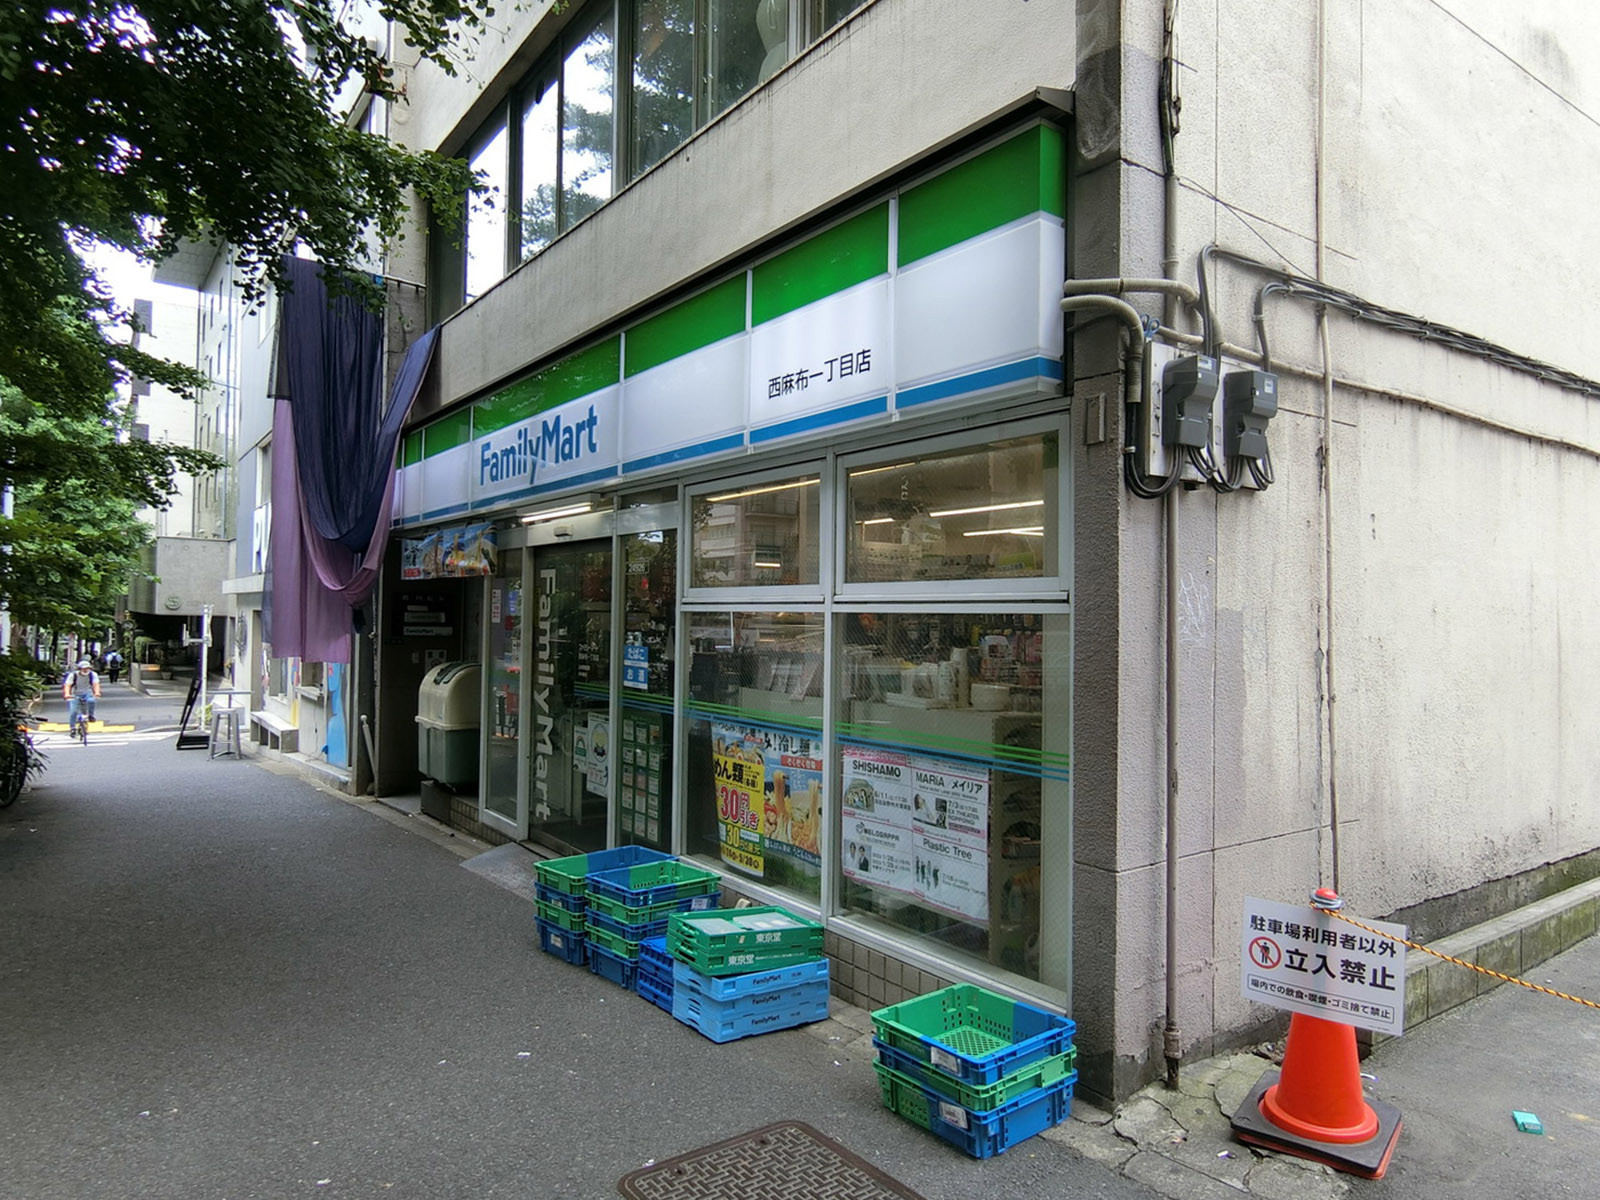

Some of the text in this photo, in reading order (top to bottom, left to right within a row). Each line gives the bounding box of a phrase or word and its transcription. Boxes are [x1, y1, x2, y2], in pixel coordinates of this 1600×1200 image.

[768, 349, 871, 399] 西麻布一丁目店
[480, 404, 599, 485] FamilyMart
[534, 568, 557, 821] FamilyMart
[852, 759, 902, 778] SHISHAMO
[915, 771, 945, 787] MARiA
[951, 780, 983, 794] メイリア
[922, 837, 973, 860] Plastic Tree
[755, 931, 782, 943] 東京堂
[1249, 914, 1397, 959] 駐車場利用者以外
[728, 953, 755, 966] 東京堂
[1284, 948, 1396, 992] 立入禁止
[752, 973, 782, 985] FamilyMart
[752, 994, 781, 1006] FamilyMart
[751, 1014, 780, 1026] FamilyMart
